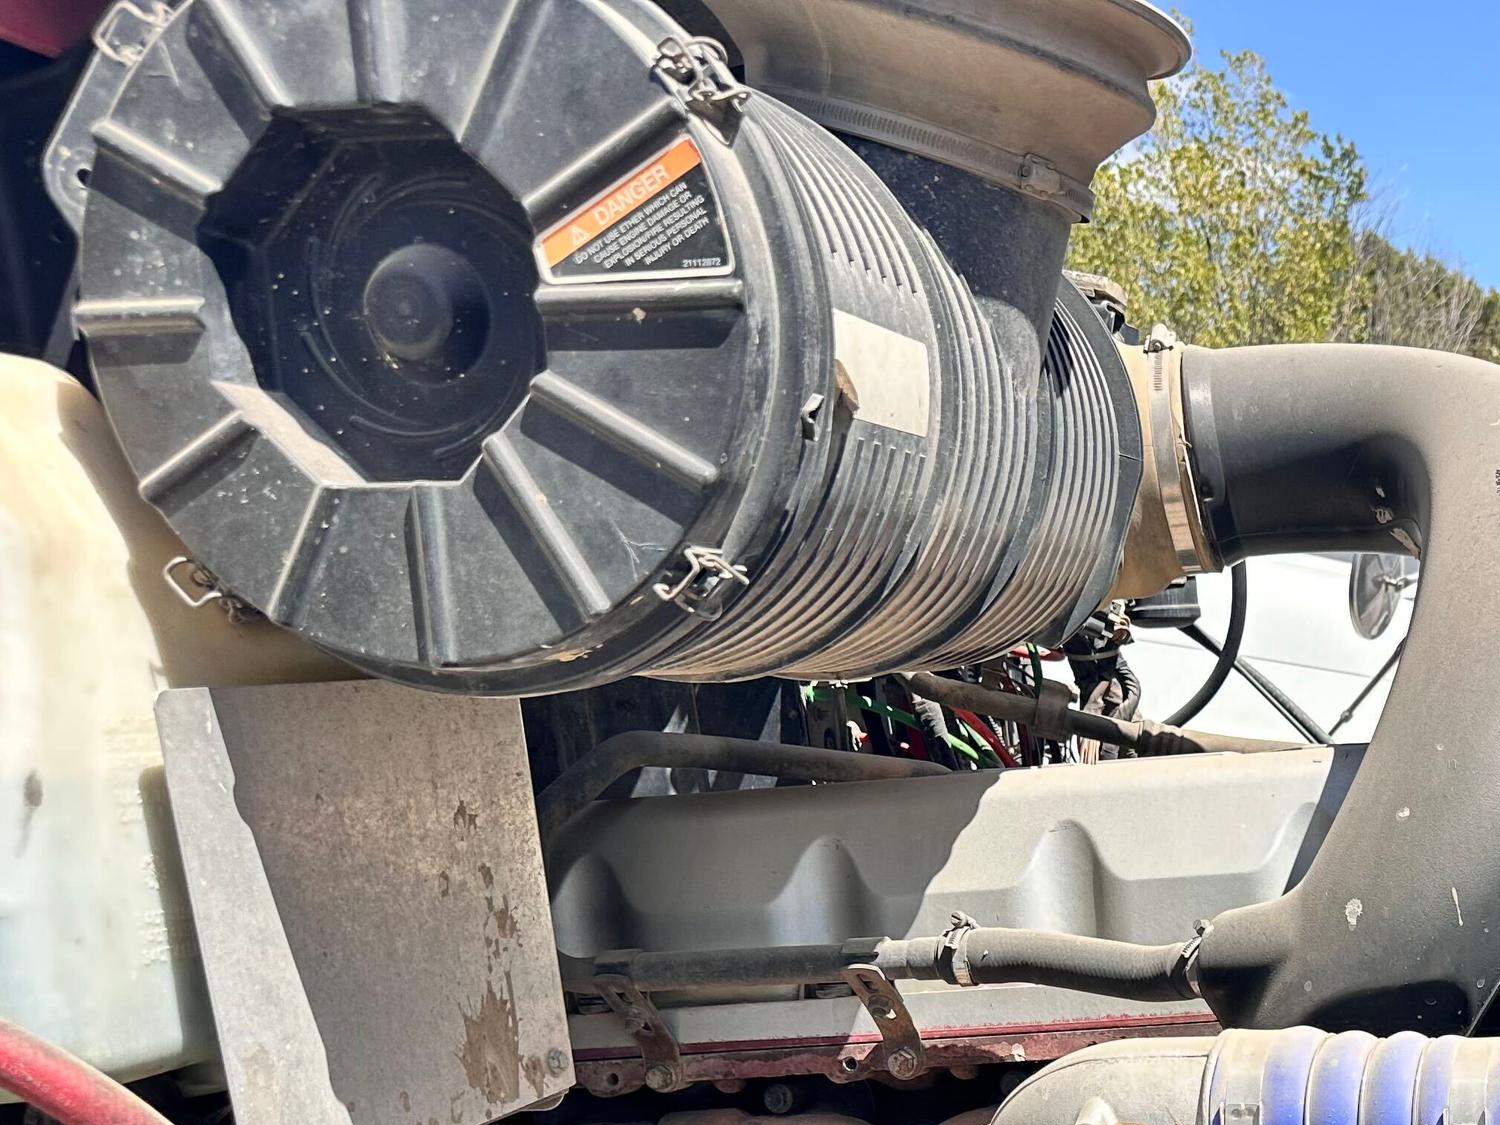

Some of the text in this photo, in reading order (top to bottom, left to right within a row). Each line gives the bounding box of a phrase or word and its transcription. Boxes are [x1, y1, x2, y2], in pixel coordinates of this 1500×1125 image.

[574, 181, 688, 264] DO NOT USE ETHER WHICH CAN
[593, 164, 670, 224] DANGER
[662, 194, 705, 227] RESULTING
[593, 190, 693, 263] CAUSE ENGINE DAMAGE OR
[624, 207, 708, 267] IN SERIOUS PERSONAL
[643, 216, 710, 266] INJURY OR DEATH
